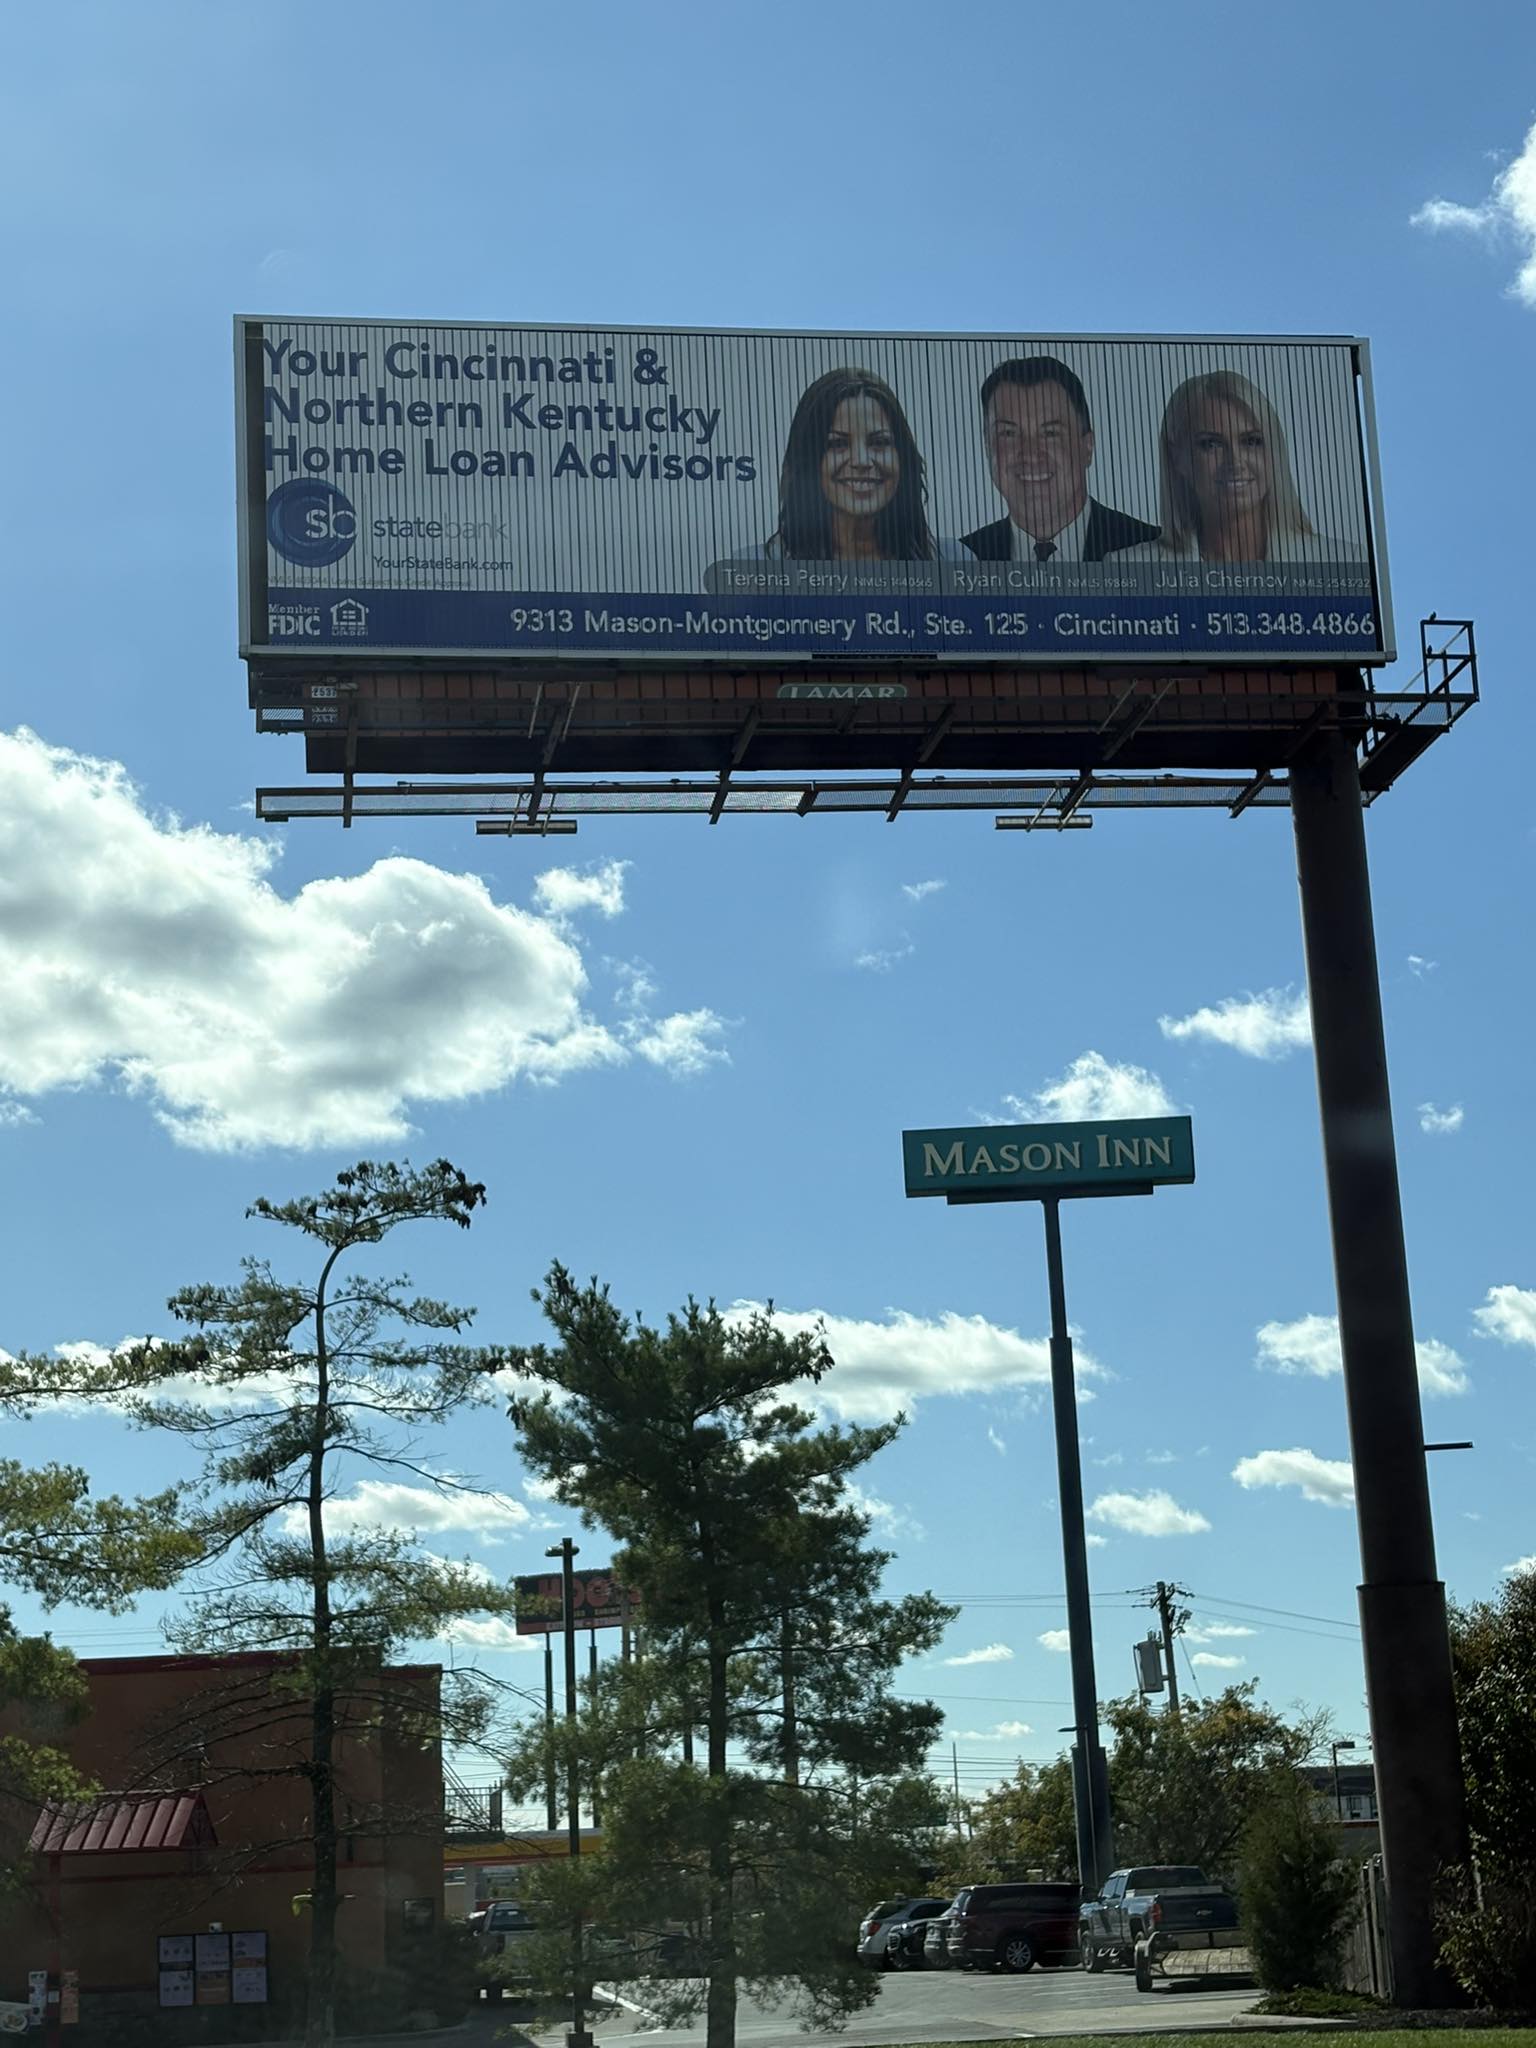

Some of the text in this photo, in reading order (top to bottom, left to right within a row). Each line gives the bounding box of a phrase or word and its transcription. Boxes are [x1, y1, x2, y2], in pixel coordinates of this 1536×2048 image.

[264, 339, 669, 385] Your Cincinnati &
[264, 387, 721, 444] Northern Kentucky
[264, 434, 757, 482] Home Loan Advisors
[305, 494, 357, 539] sb
[373, 556, 513, 571] YourStateBank.com
[723, 569, 790, 587] Terena
[798, 570, 848, 592] Perry
[953, 570, 1001, 592] Ryan
[1008, 570, 1061, 588] Cullin
[1155, 571, 1199, 588] Julia
[268, 603, 320, 614] Member
[268, 615, 321, 636] FDIC
[510, 608, 1376, 642] 9313 Mason-Montgomery Rd., Ste. 125 Cincinnati 513.348.4866
